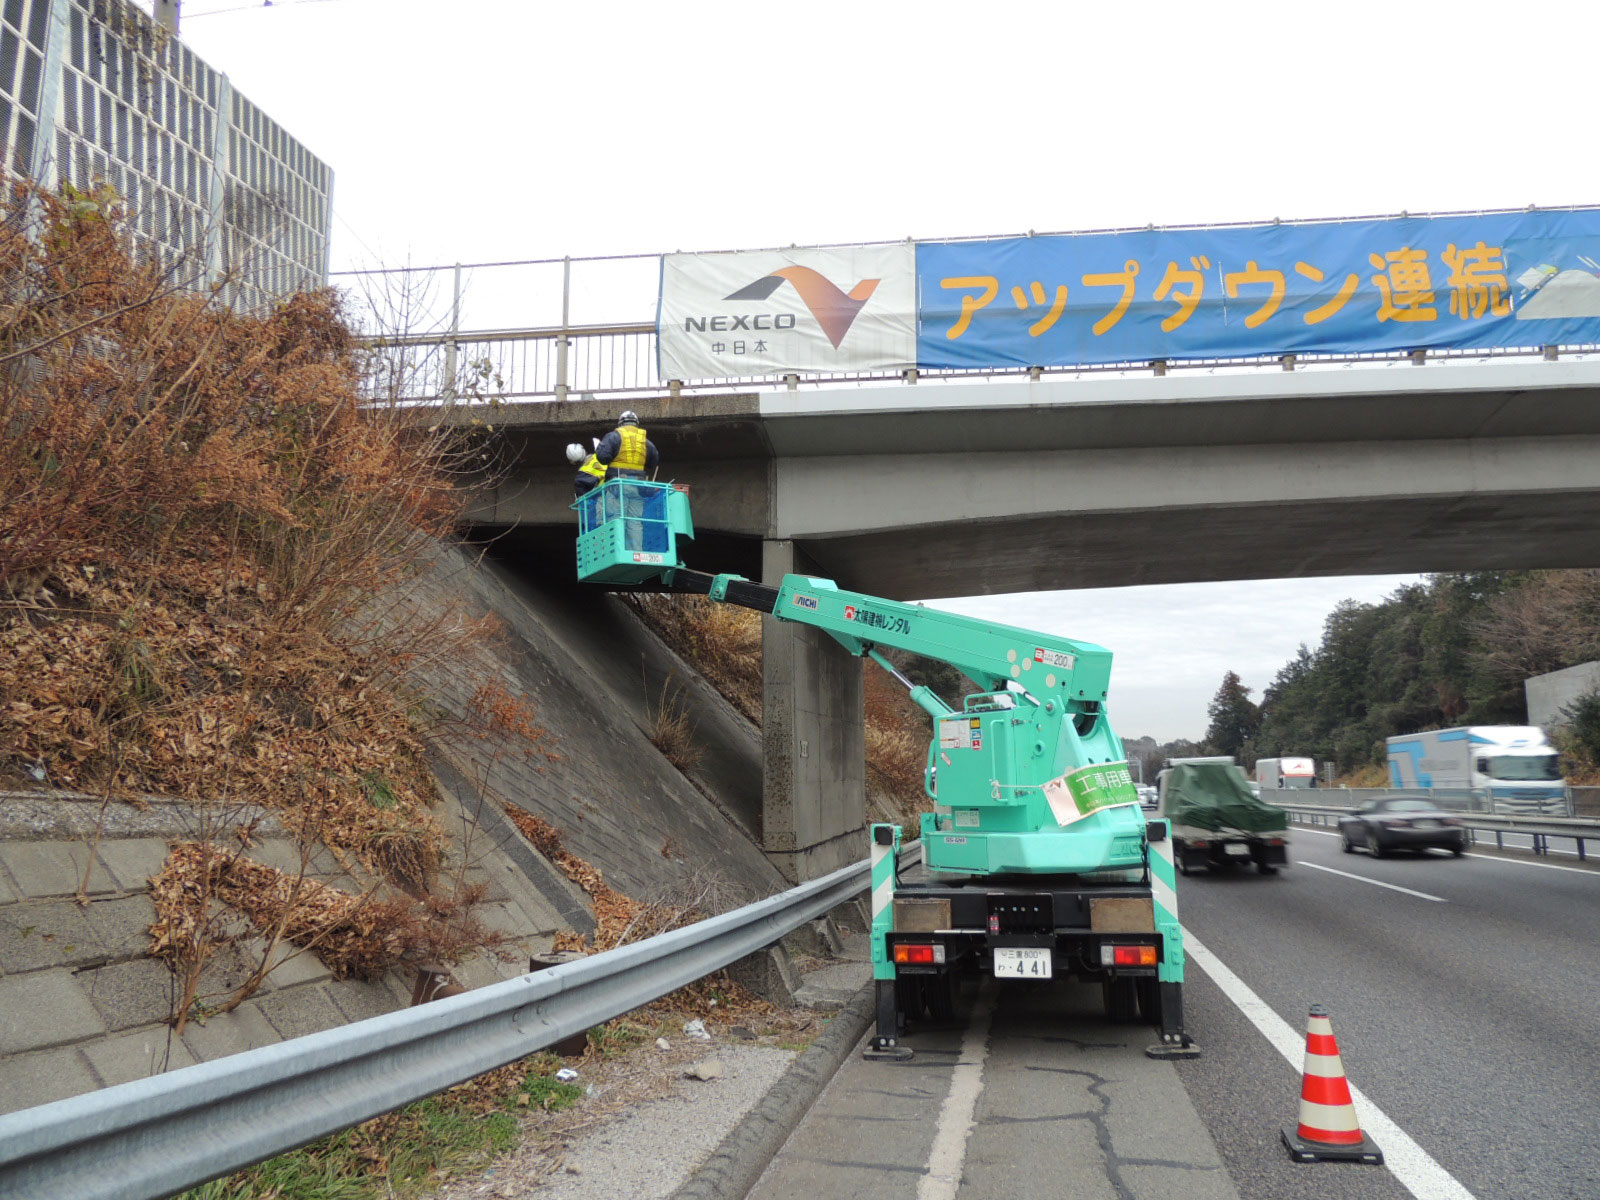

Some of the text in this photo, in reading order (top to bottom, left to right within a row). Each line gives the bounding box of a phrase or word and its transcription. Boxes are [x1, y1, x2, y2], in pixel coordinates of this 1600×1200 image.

[940, 243, 1510, 339] アップダウン連続
[685, 313, 796, 332] NEXCO
[711, 340, 768, 355] 中日本
[797, 596, 817, 609] AICHI
[1054, 654, 1069, 667] 200
